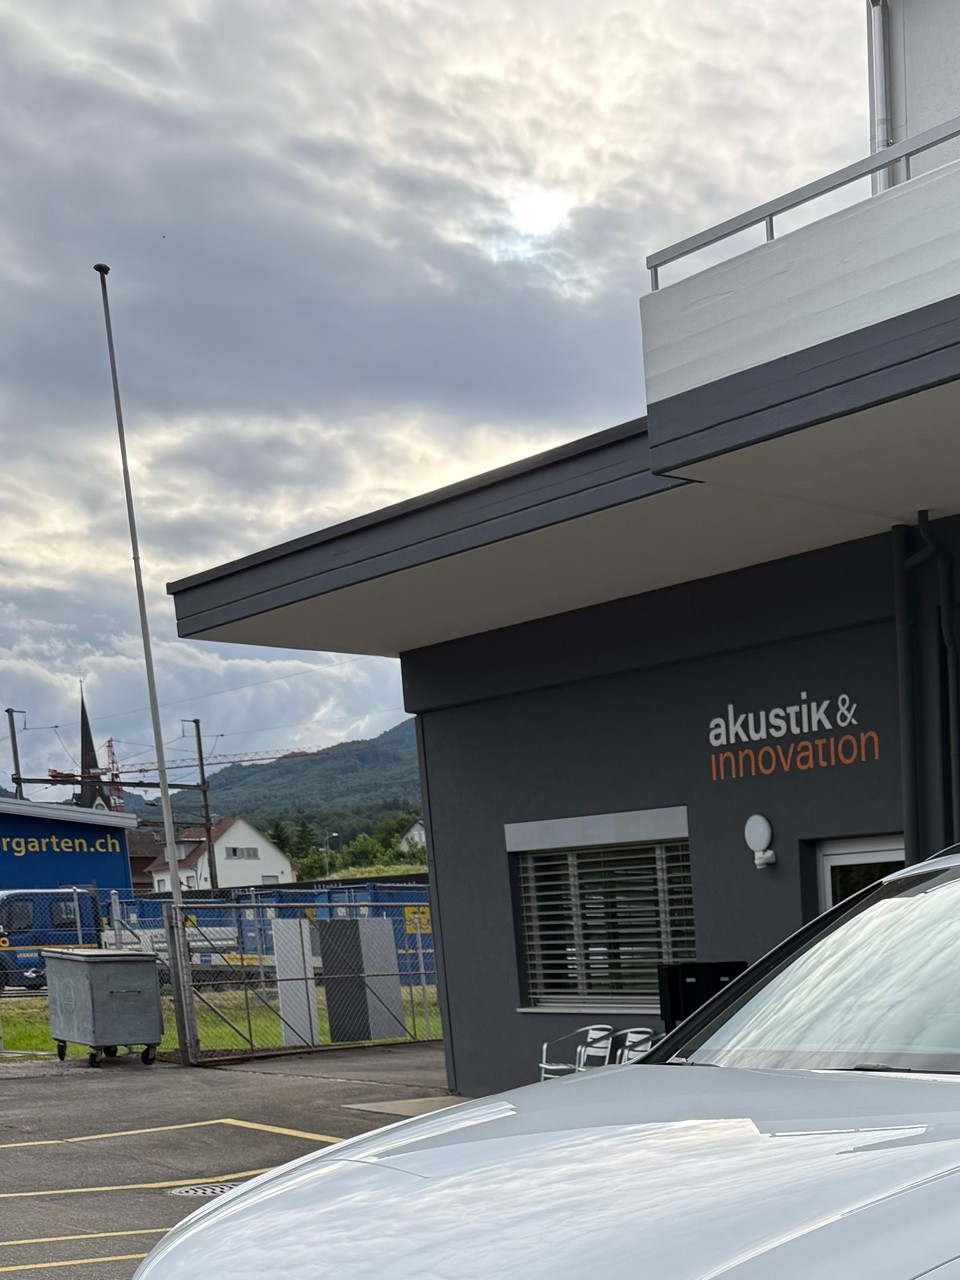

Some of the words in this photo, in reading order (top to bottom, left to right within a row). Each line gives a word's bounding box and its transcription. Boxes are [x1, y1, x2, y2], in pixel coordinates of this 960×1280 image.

[708, 691, 833, 748] akustik
[835, 693, 859, 728] &
[710, 730, 880, 781] innovation
[1, 833, 121, 857] rgarten.ch
